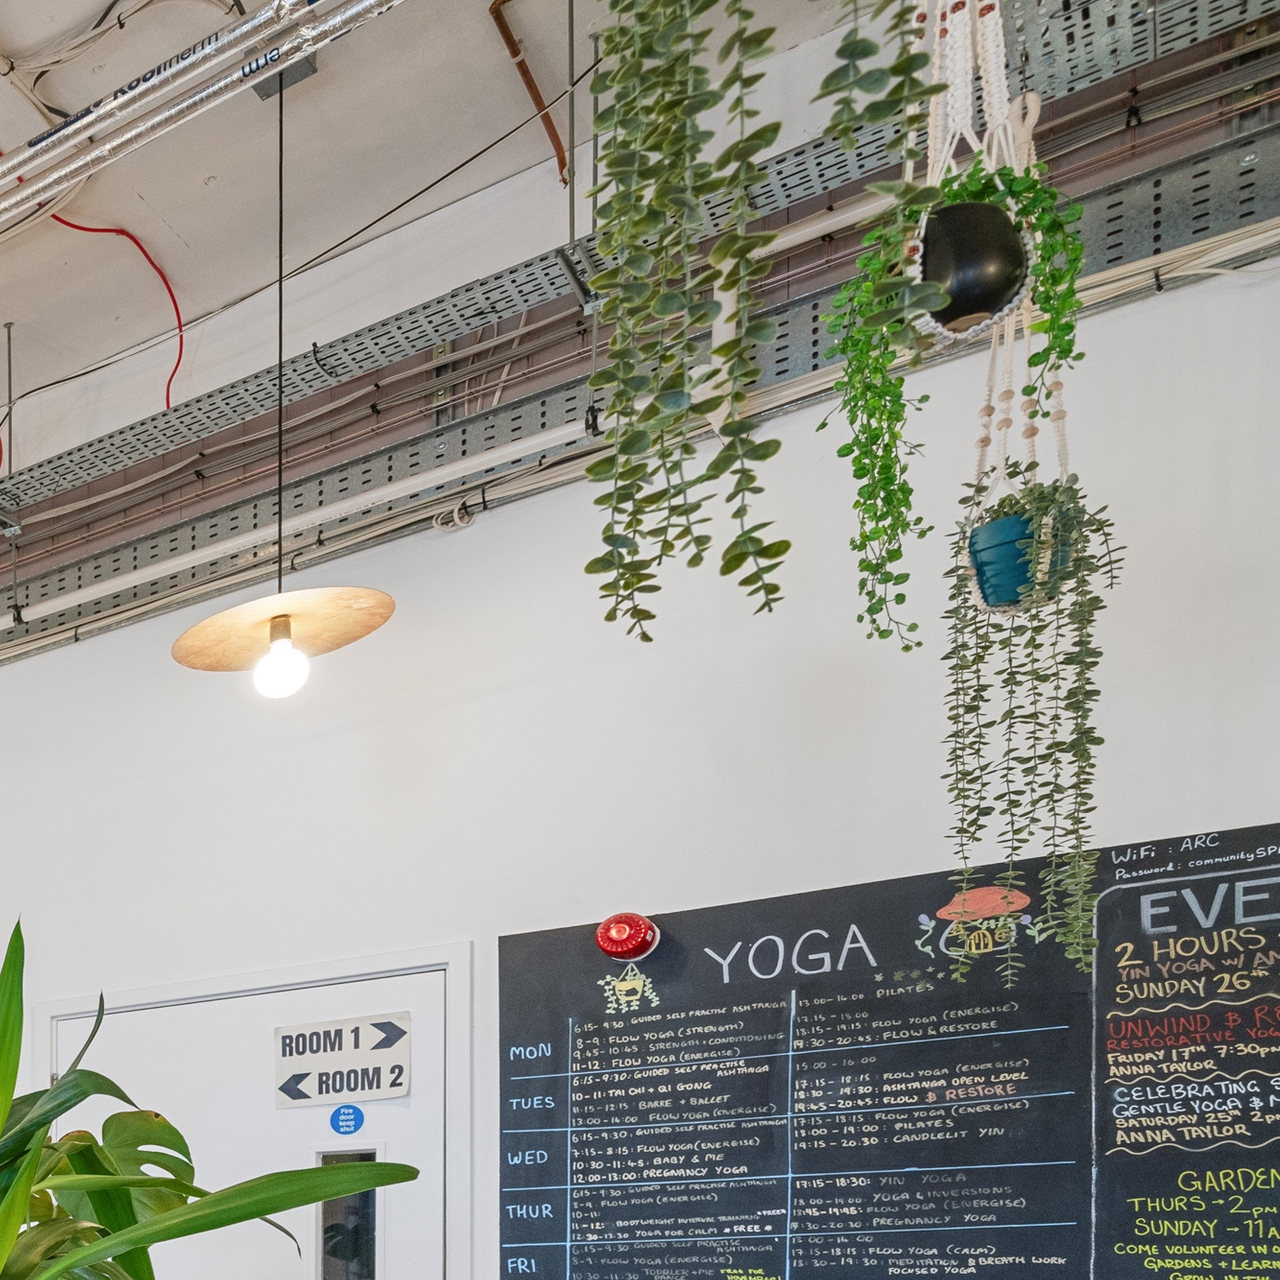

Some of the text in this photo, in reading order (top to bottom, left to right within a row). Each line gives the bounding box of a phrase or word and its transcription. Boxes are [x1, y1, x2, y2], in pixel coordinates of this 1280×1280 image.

[1111, 833, 1220, 864] WiFi ARC
[703, 924, 877, 984] YOGA
[1115, 927, 1266, 967] 2 HOURS
[1118, 958, 1215, 982] YIN YOGA
[1115, 976, 1206, 1004] SUNDAY
[939, 1020, 998, 1034] RESTORE
[1109, 1014, 1210, 1039] UNWIND
[281, 1026, 360, 1057] ROOM 1
[1107, 1030, 1236, 1051] RESTORATIVE
[509, 1043, 551, 1060] MON
[1107, 1050, 1165, 1065] FRIDAY
[1109, 1059, 1218, 1077] ANNA TAYLOR
[317, 1064, 404, 1095] ROOM 2
[990, 1072, 1028, 1082] LEVEL
[945, 1083, 1017, 1100] RESTORE
[1113, 1080, 1260, 1102] CELEBRATING
[509, 1096, 555, 1110] TUES
[1112, 1098, 1242, 1118] GENTLE YOGA
[894, 1119, 954, 1131] PILATES
[1115, 1113, 1198, 1128] SATURDAY
[893, 1127, 1005, 1144] CANDLELIT YIN
[508, 1150, 548, 1165] WED
[705, 1153, 725, 1162] ME
[715, 1165, 748, 1175] YOGA
[506, 1204, 554, 1219] THUR
[1126, 1196, 1206, 1212] THURS
[1134, 1218, 1218, 1239] SUNDAY
[1114, 1243, 1247, 1254] COME VOLUNTEER
[507, 1258, 536, 1274] FRI
[888, 1266, 976, 1275] FOCUSED YOGA
[1144, 1258, 1212, 1272] GARDENS
